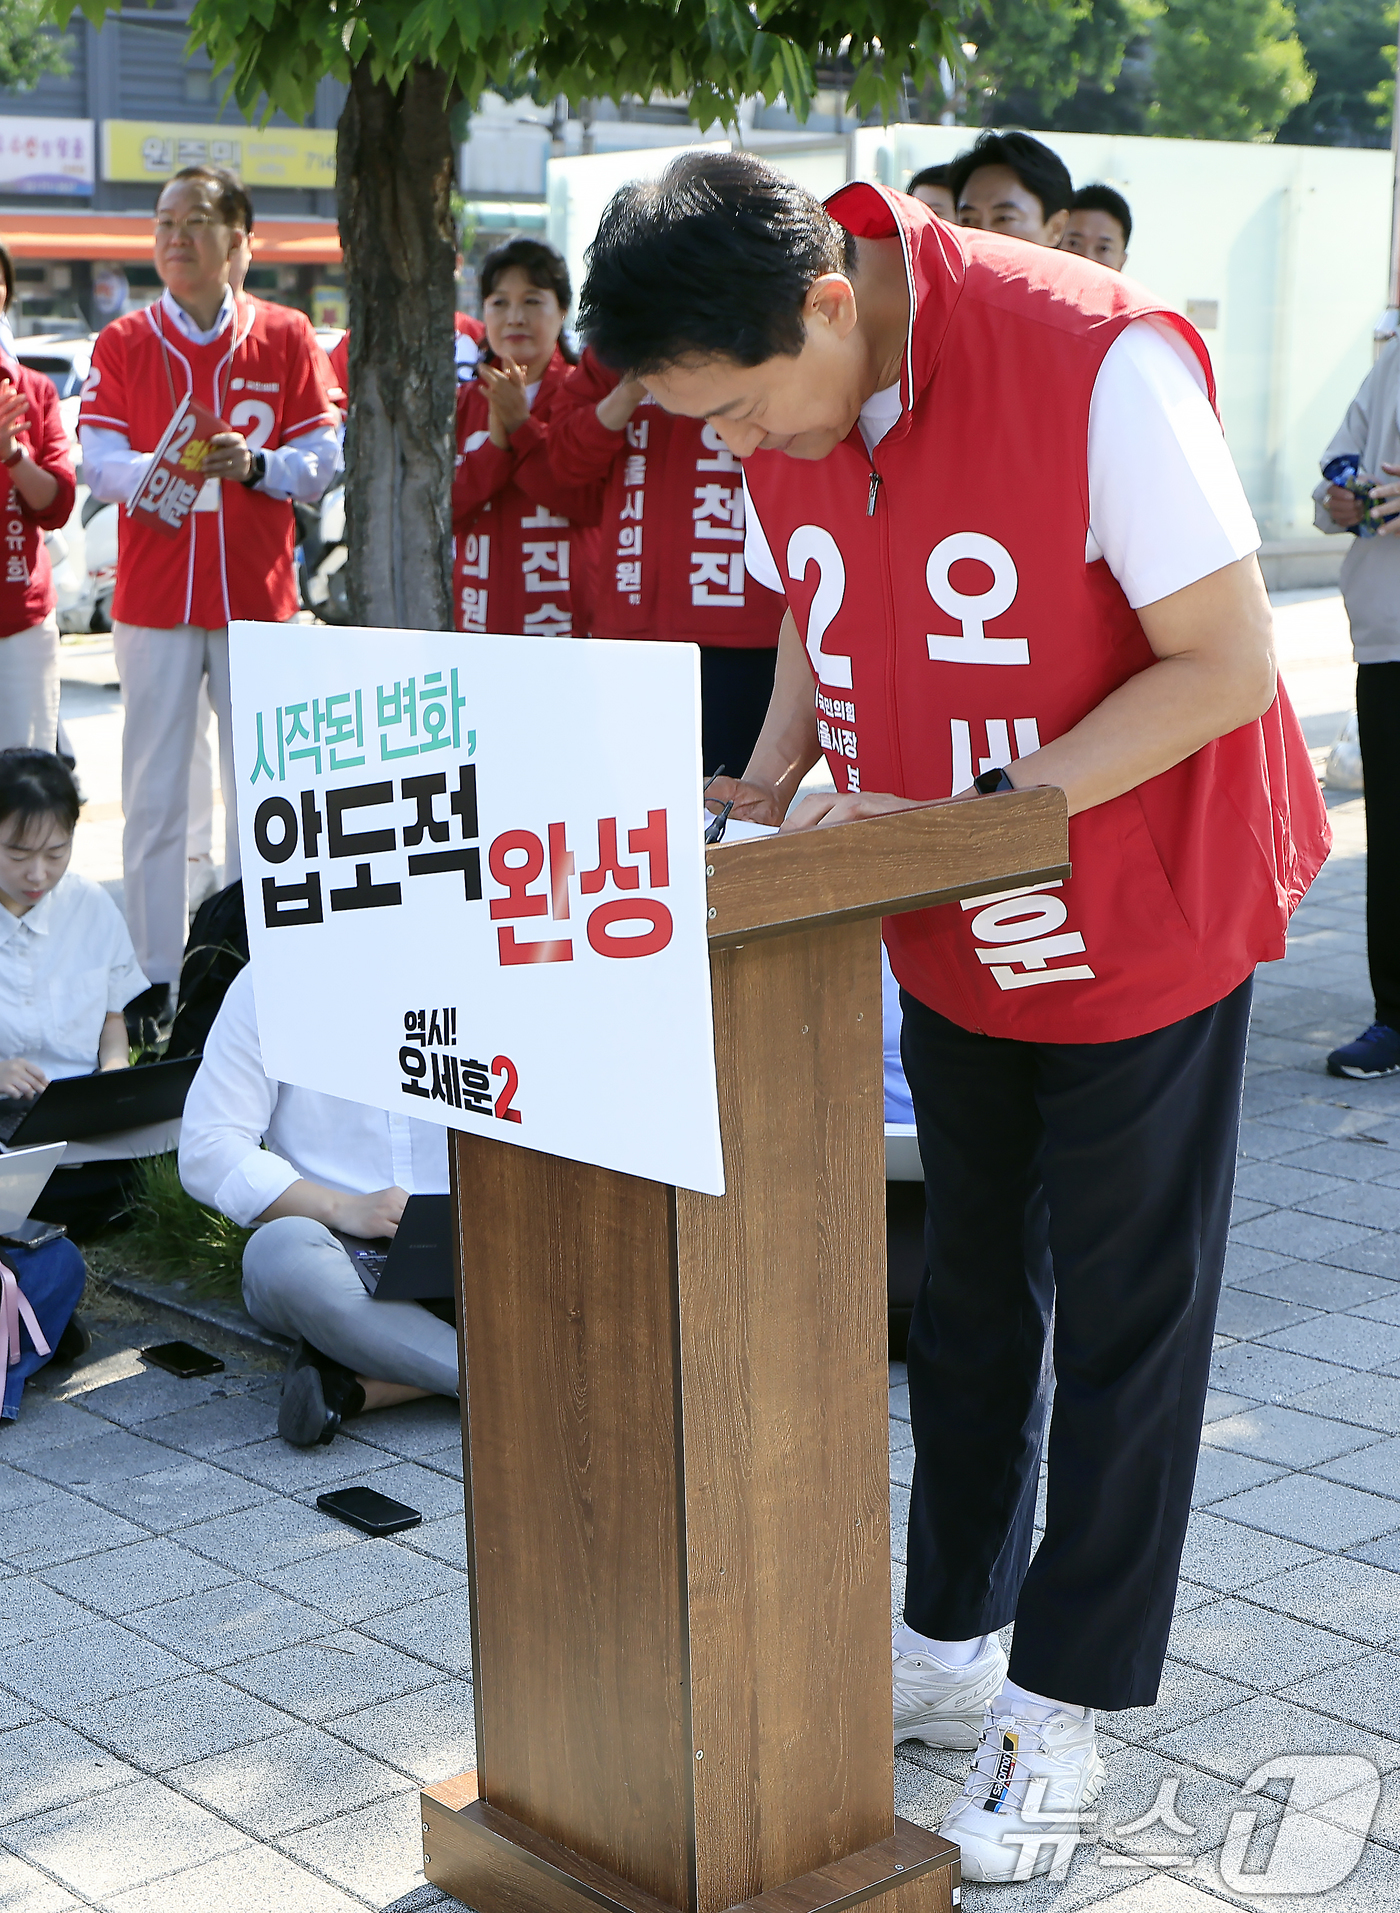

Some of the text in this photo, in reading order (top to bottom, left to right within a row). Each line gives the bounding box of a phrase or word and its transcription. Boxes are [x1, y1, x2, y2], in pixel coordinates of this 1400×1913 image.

[138, 467, 199, 528] 오세훈
[787, 524, 853, 690] 2
[249, 667, 478, 785] 시작된 변화,
[816, 717, 858, 760] 울시장
[254, 764, 674, 967] 압도적 완성
[403, 1006, 458, 1048] 역시!
[953, 1671, 1000, 1708] S-LAB
